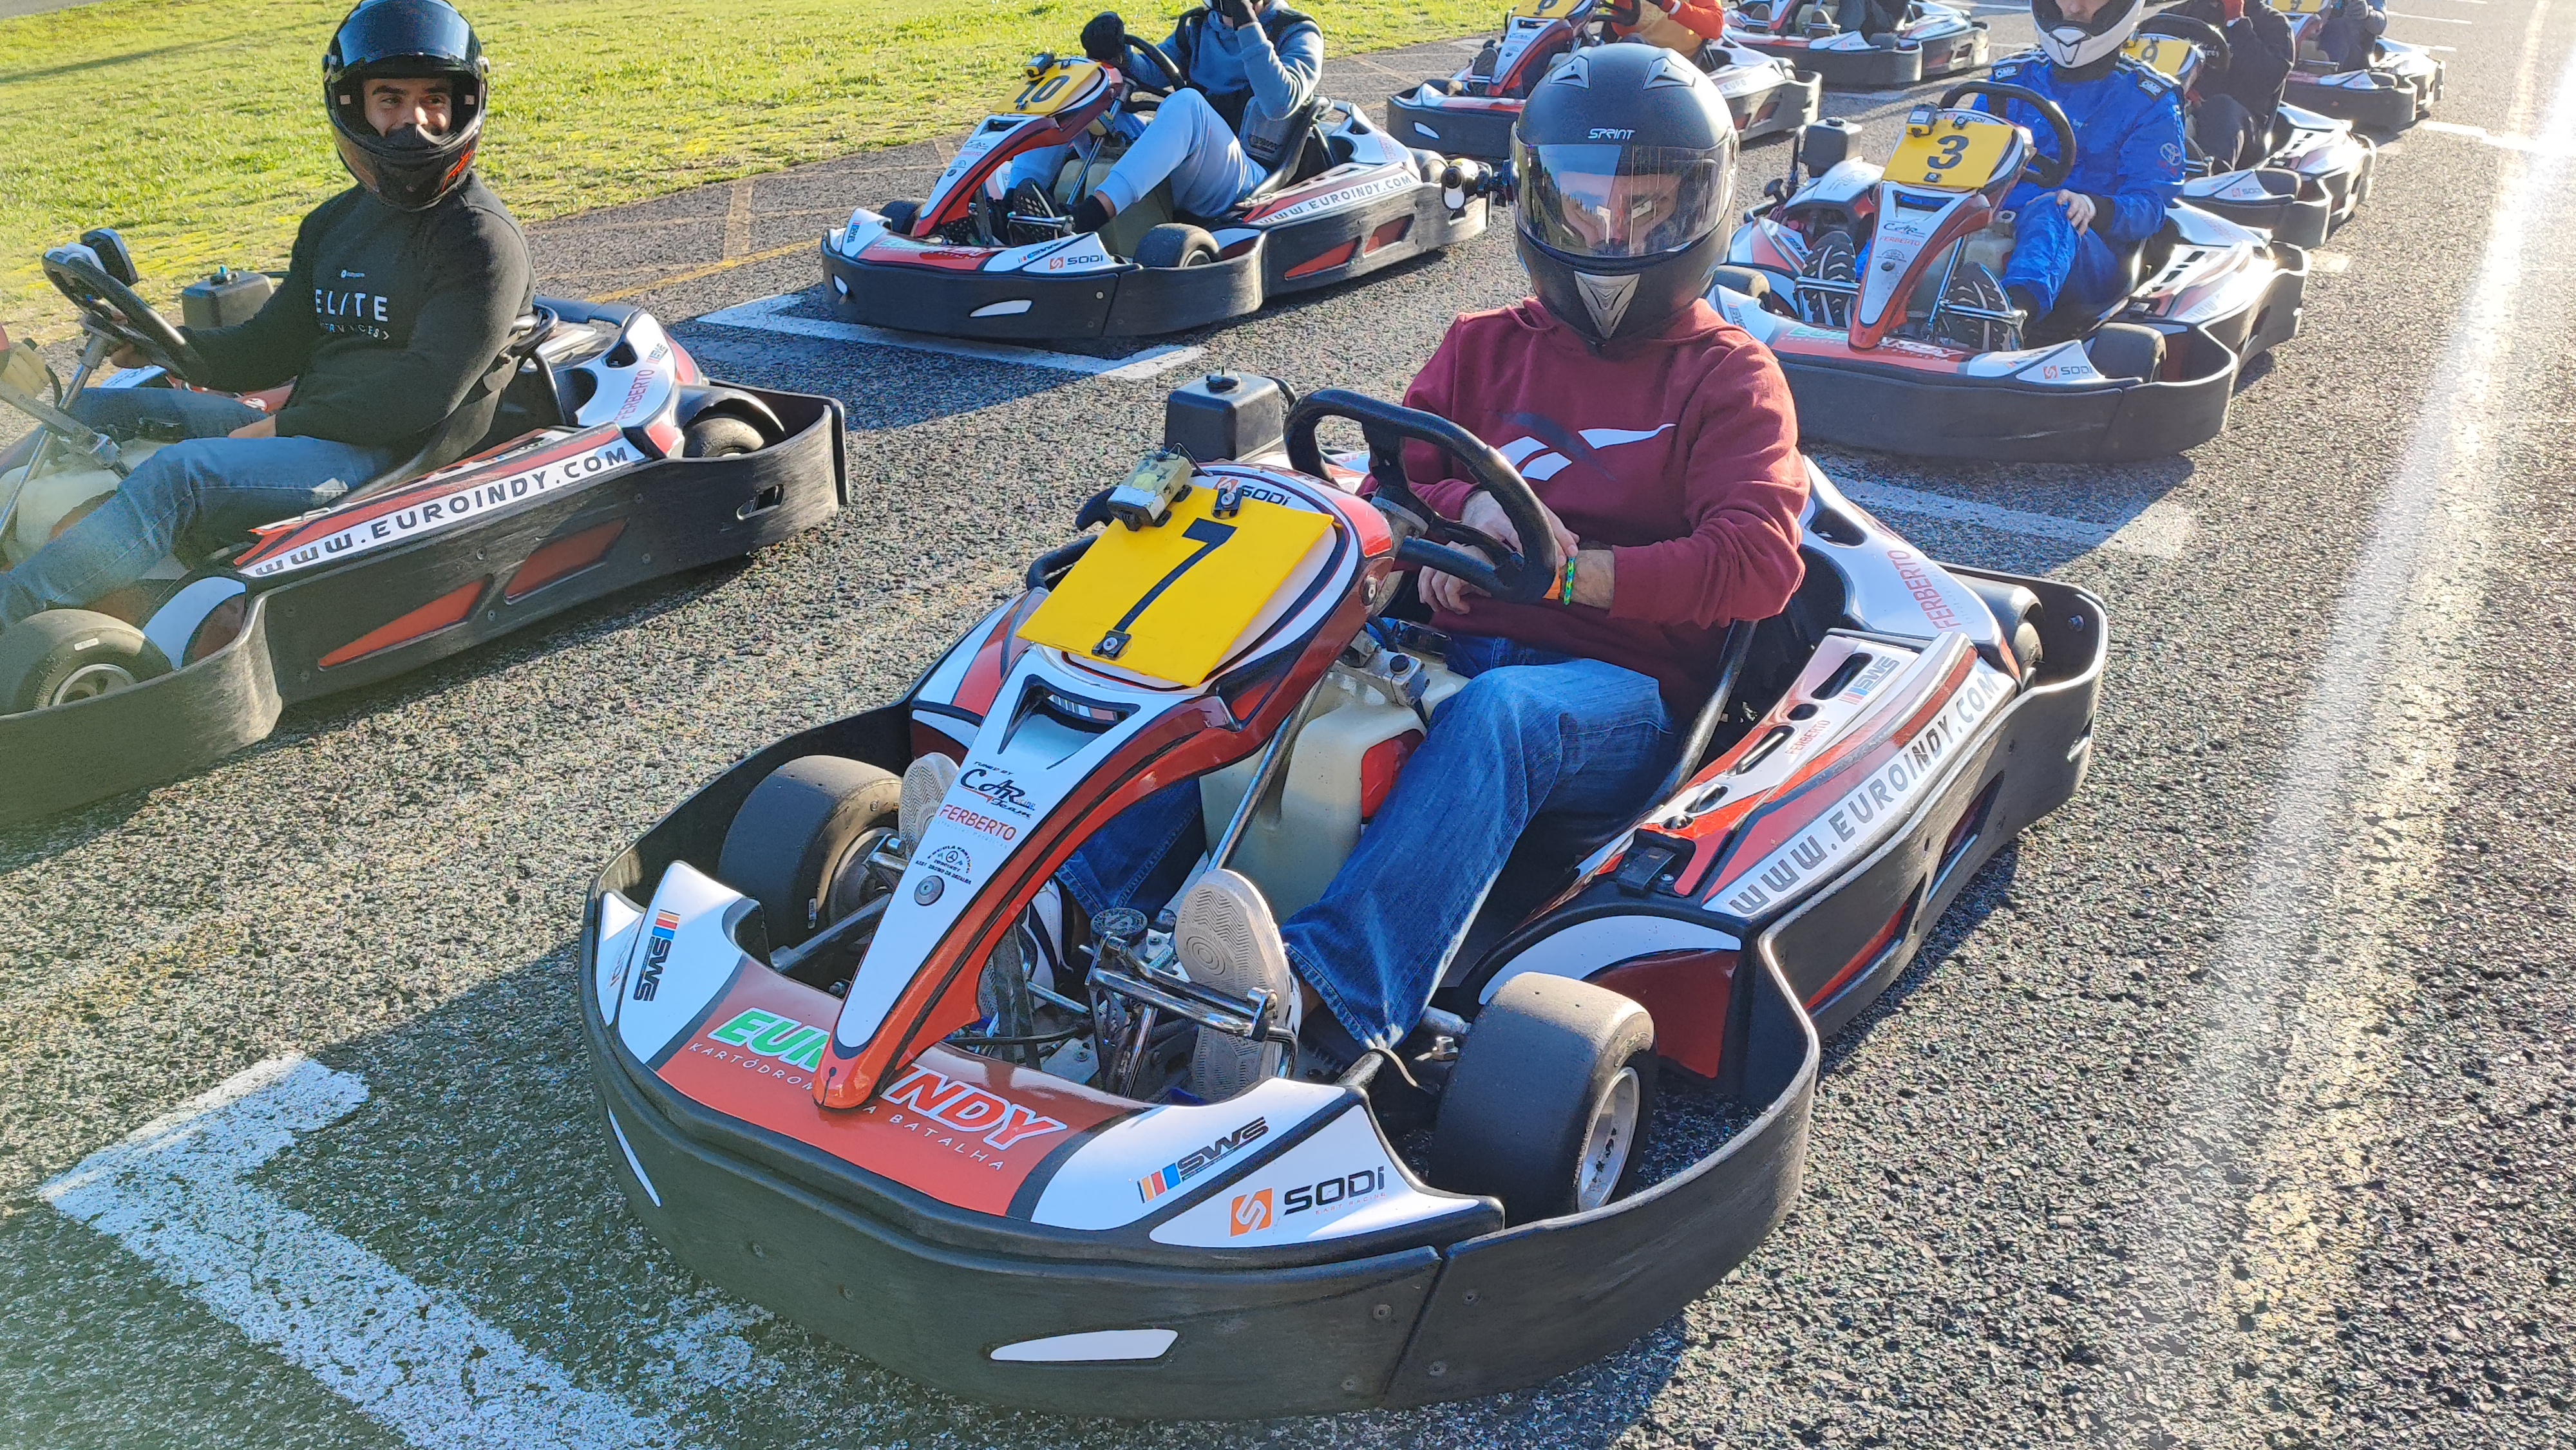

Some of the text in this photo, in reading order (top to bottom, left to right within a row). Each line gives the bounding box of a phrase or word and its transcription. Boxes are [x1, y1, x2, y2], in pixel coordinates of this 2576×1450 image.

[1014, 75, 1070, 104] 10
[1587, 127, 1636, 140] SPRINT
[1927, 135, 1969, 169] 3
[1067, 255, 1103, 265] SODI
[316, 289, 388, 322] ELITE
[1113, 518, 1238, 632] 7
[1887, 550, 1962, 630] FERBERTO
[1853, 655, 1900, 692] SWS
[1785, 720, 1831, 755] FERBERTO
[938, 804, 1017, 841] FERBERTO
[633, 936, 672, 1002] SWS
[889, 1114, 1005, 1171] BATALHA
[1177, 1116, 1269, 1182] SWS
[1283, 1165, 1385, 1216] SODI
[1349, 1192, 1386, 1206] RACING
